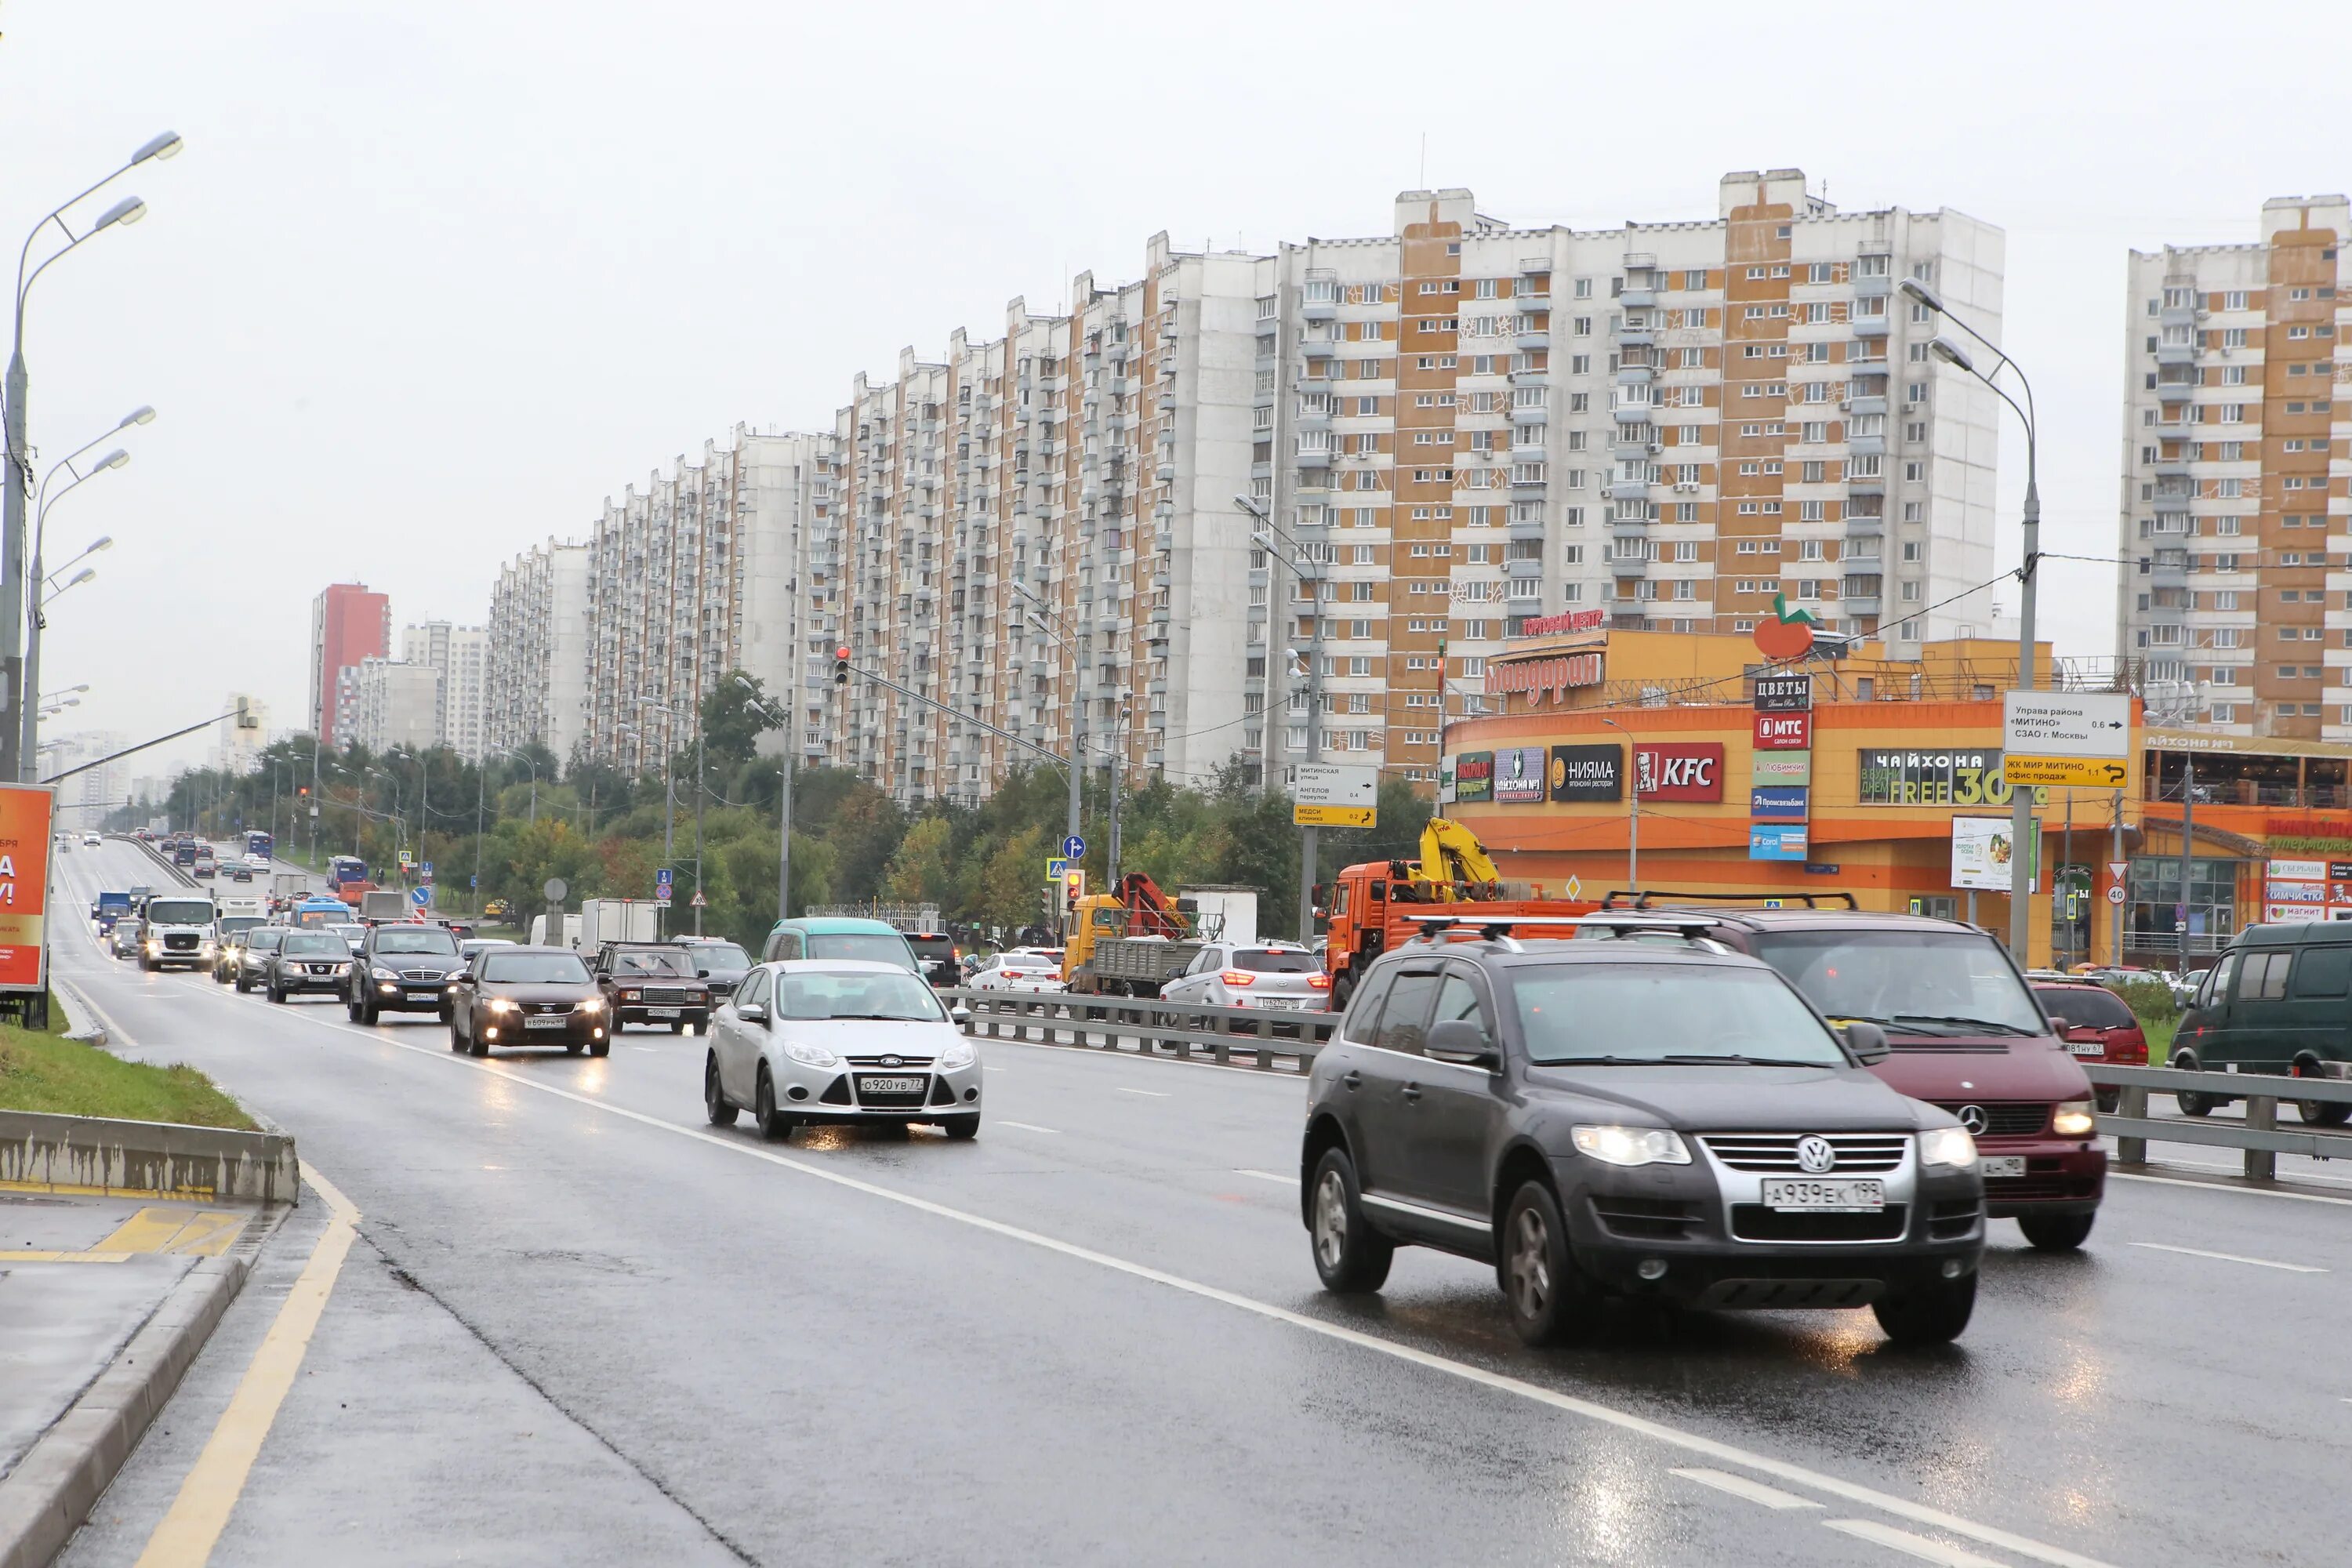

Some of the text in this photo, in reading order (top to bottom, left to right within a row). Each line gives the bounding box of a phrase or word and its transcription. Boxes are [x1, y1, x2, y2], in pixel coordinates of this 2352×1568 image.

[1523, 608, 1603, 636] ТОРГОВЫЙ ЦЕНТР
[1758, 681, 1806, 698] ЦВЕТЫ
[2016, 706, 2083, 717] Управа района
[1774, 720, 1802, 735] МТС
[2010, 718, 2060, 727] «МИТИНО»
[2015, 730, 2042, 739] СЗАО
[2051, 731, 2088, 740] Москвы
[1568, 761, 1614, 779] НИЯМА
[2045, 762, 2085, 771] МИТИНО
[1661, 758, 1713, 786] KFC
[2007, 771, 2031, 780] офис
[2033, 772, 2067, 781] продаж
[1890, 782, 1948, 804] FREE
[1762, 798, 1804, 808] Промсвязьбанк
[2282, 865, 2322, 873] СБЕРБАНК
[2110, 891, 2123, 900] 40
[2287, 907, 2321, 916] магнит
[865, 1080, 907, 1090] О920УВ
[1772, 1183, 1878, 1203] А939ЕК 199
